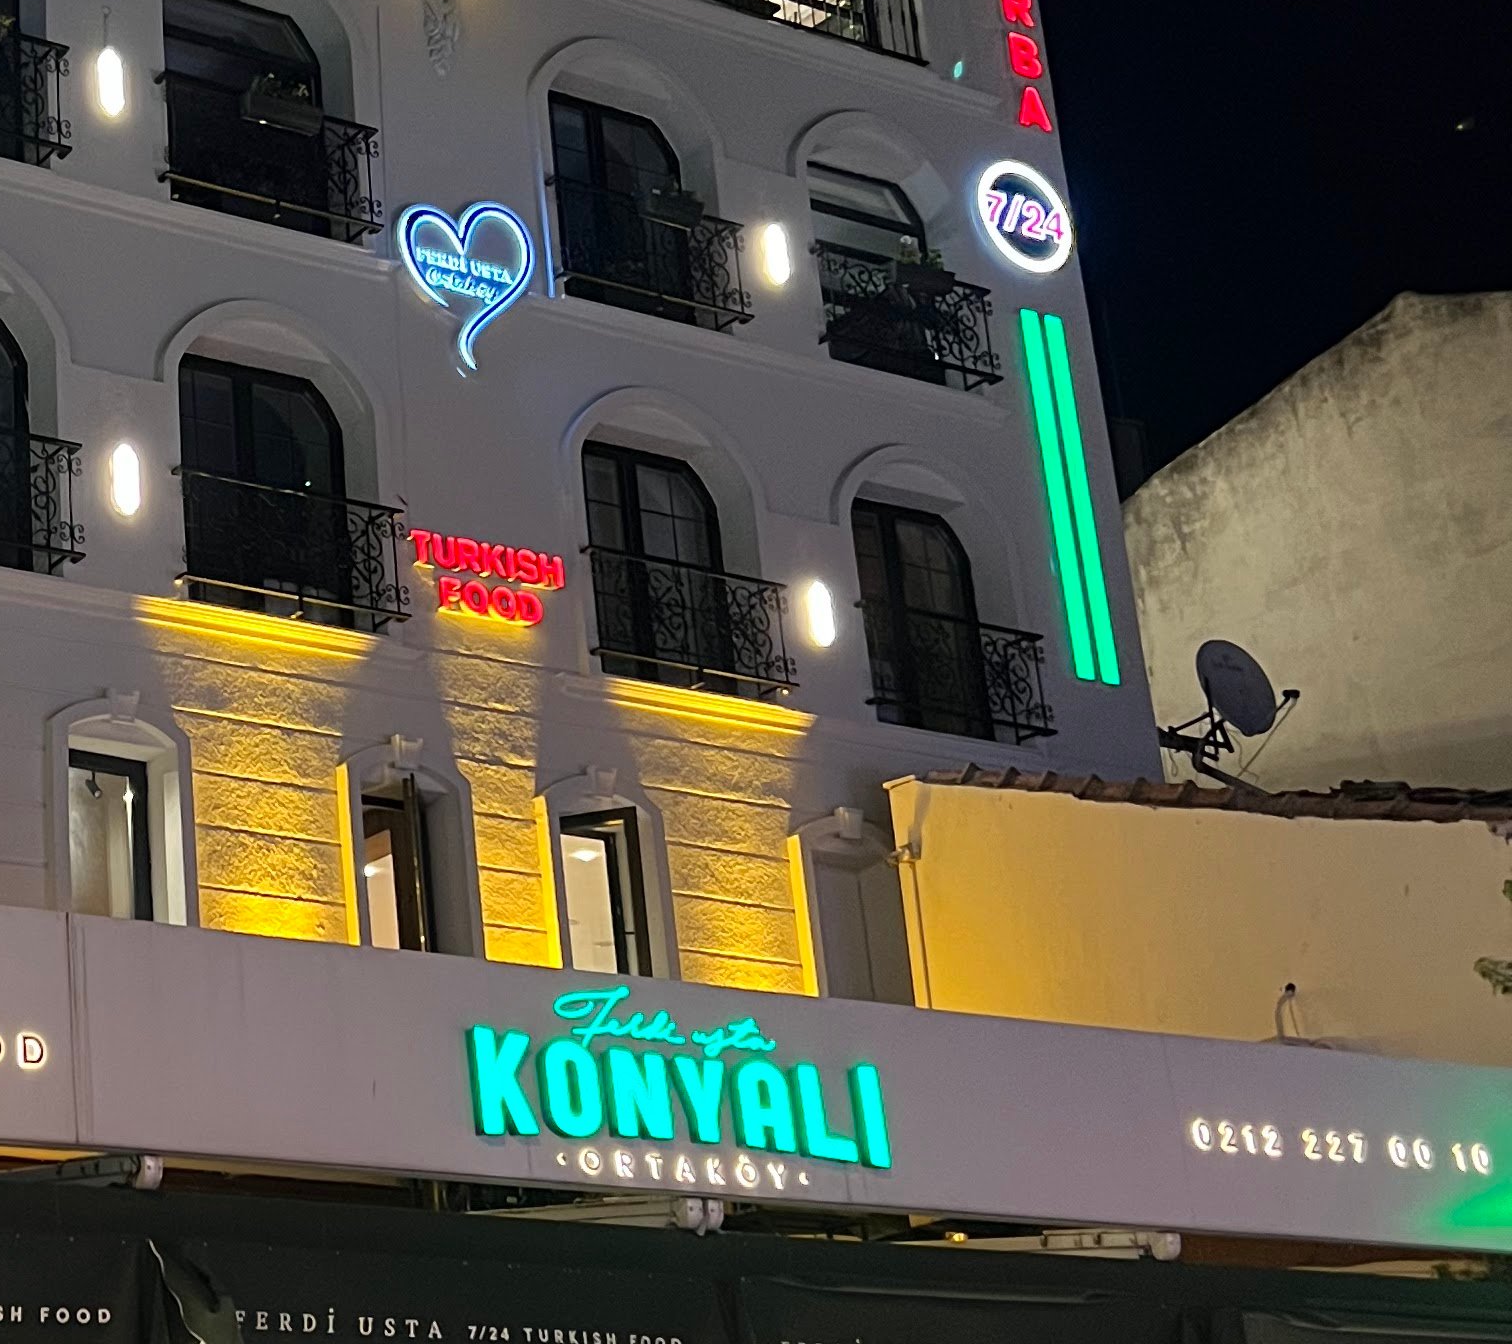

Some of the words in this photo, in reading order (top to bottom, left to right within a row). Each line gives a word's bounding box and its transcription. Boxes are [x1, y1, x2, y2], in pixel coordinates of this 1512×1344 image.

[986, 189, 1065, 244] 7/24
[407, 528, 566, 590] TURKISH
[438, 575, 545, 626] FOOD
[468, 1023, 892, 1170] KONYALI
[577, 1146, 786, 1191] ORTAKÖY
[1191, 1117, 1283, 1158] 0212
[1301, 1128, 1367, 1164] 227
[1388, 1134, 1434, 1170] 00
[1451, 1142, 1491, 1175] 10
[40, 1306, 111, 1324] FOOD
[358, 1316, 442, 1339] USTA
[468, 1325, 510, 1341] 7/24
